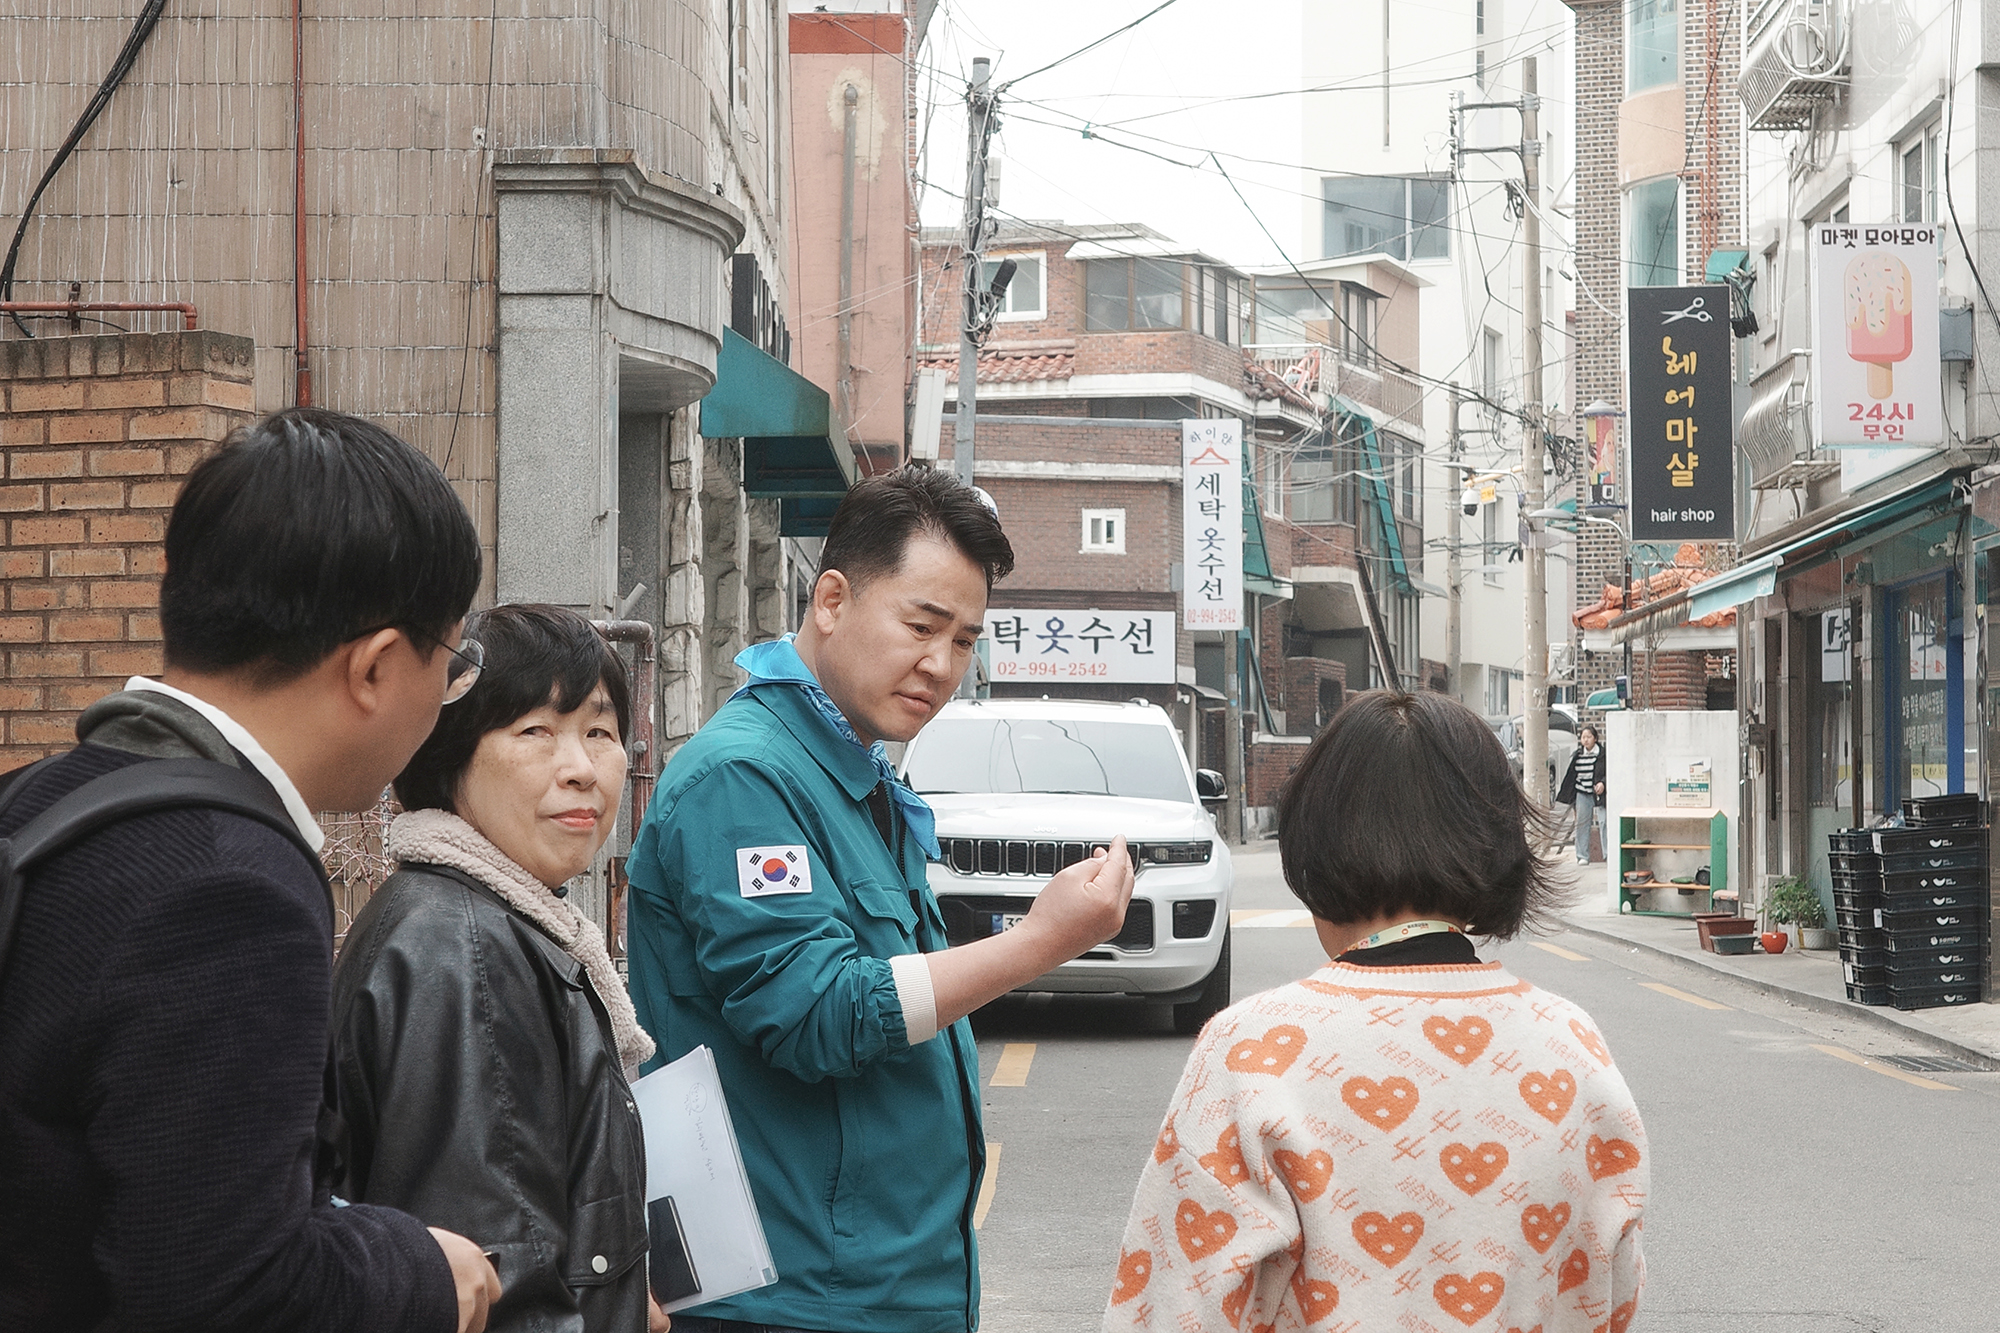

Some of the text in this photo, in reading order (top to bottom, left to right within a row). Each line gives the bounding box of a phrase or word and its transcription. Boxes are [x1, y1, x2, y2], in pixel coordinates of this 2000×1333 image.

[1821, 229, 1935, 249] 마켓 모아모아
[1847, 402, 1914, 421] 24시
[1863, 424, 1904, 441] 무인
[1651, 508, 1715, 523] hair shop
[1187, 608, 1236, 623] 02-994-2542
[997, 662, 1107, 676] 02-994-2542
[1034, 825, 1058, 834] Jeep
[1376, 1041, 1450, 1086] HAPPY
[1546, 1037, 1599, 1079] HAPPY
[1302, 1112, 1368, 1155] HAPPY
[1474, 1107, 1541, 1148] HAPPY
[1395, 1175, 1455, 1219] HAPPY
[1142, 1213, 1174, 1272] HAPPY
[1311, 1246, 1371, 1288] HAPPY
